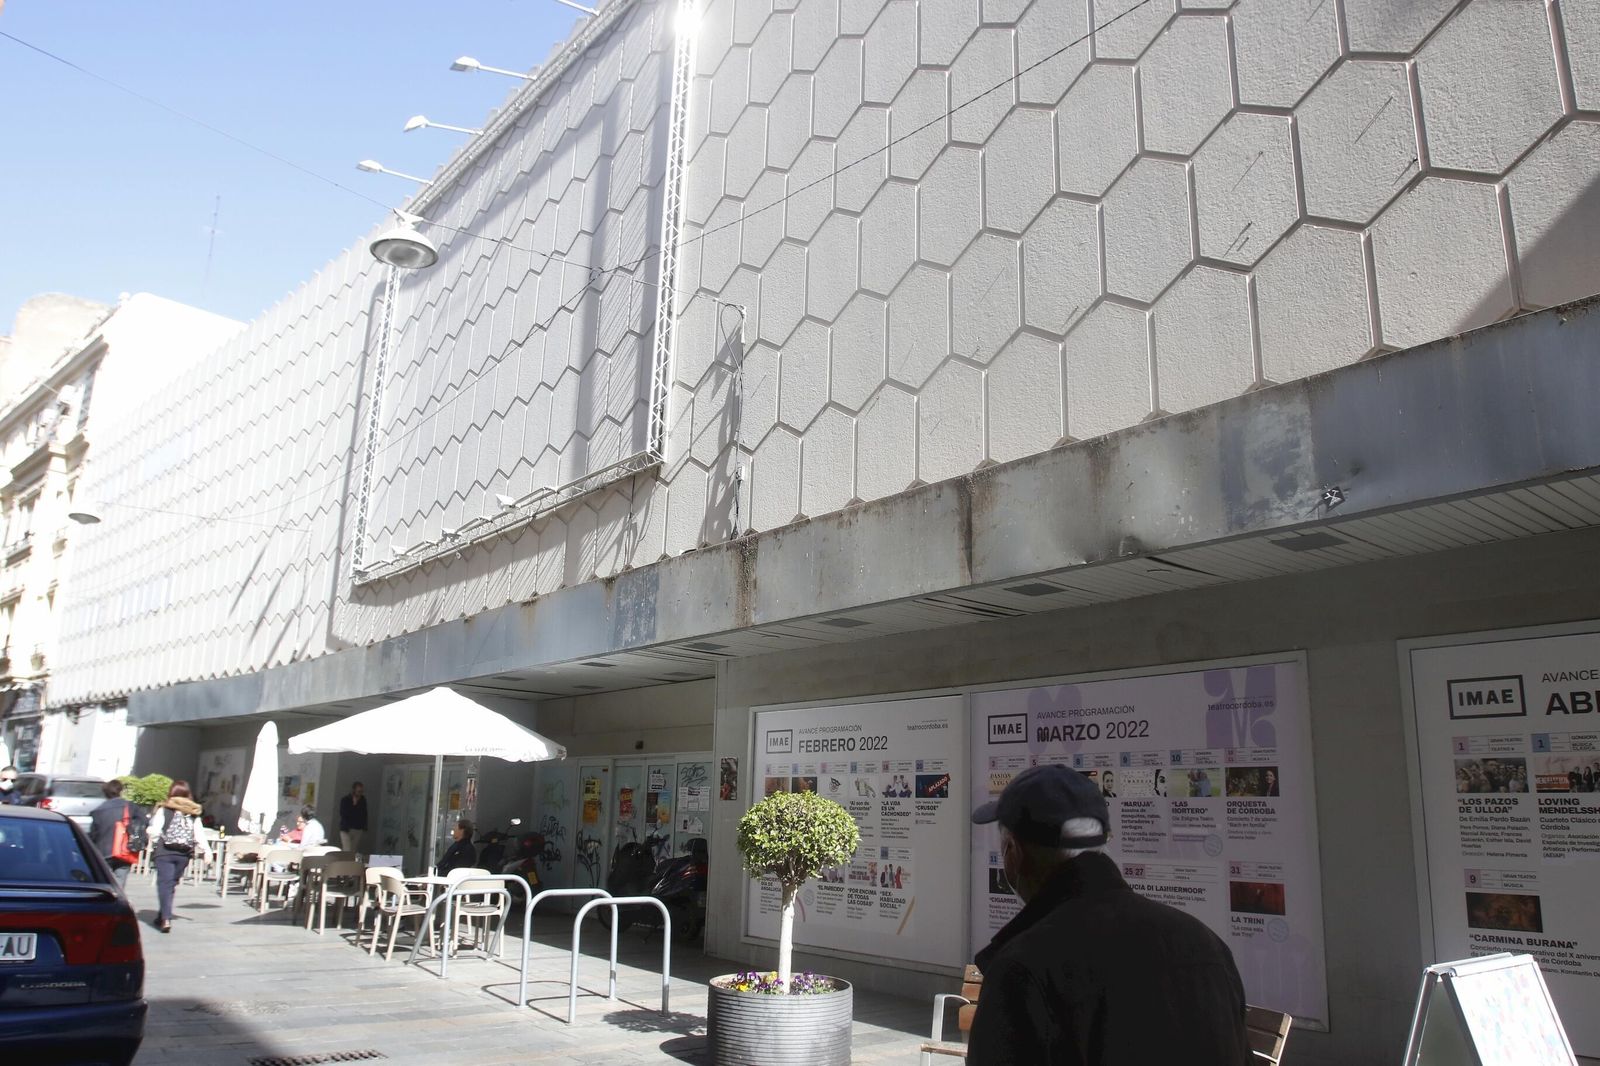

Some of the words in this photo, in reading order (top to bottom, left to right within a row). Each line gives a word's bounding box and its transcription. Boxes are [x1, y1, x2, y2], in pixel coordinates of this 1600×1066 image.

[1542, 669, 1599, 683] AVANCE
[1459, 689, 1514, 706] IMAE
[1546, 690, 1600, 716] AB
[1207, 700, 1274, 711] teatrocordoba.es
[1037, 710, 1066, 719] AVANCE
[1068, 705, 1135, 717] PROGRAMACIÓN
[906, 723, 948, 731] teatrocordoba.es
[993, 723, 1022, 735] IMAE
[1037, 724, 1101, 743] MARZO
[1106, 720, 1149, 739] 2022
[769, 737, 789, 747] IMAE
[799, 738, 856, 752] FEBRERO
[860, 736, 888, 751] 2022
[1171, 754, 1181, 762] 10
[927, 775, 949, 793] APLAZADO
[1458, 798, 1482, 806] "LOS
[1485, 798, 1519, 806] PAZOS
[1538, 798, 1580, 806] LOVING
[1459, 806, 1473, 814] DE
[1474, 806, 1513, 814] ULLOA"
[1124, 867, 1133, 876] 25
[1135, 868, 1144, 876] 27
[1231, 865, 1241, 874] 31
[1243, 917, 1265, 925] TRINI
[1469, 934, 1524, 946] "CARMINA
[1526, 938, 1578, 950] BURANA"
[1470, 944, 1502, 952] Concierto
[1556, 951, 1568, 959] del
[1560, 969, 1593, 977] Konstantin
